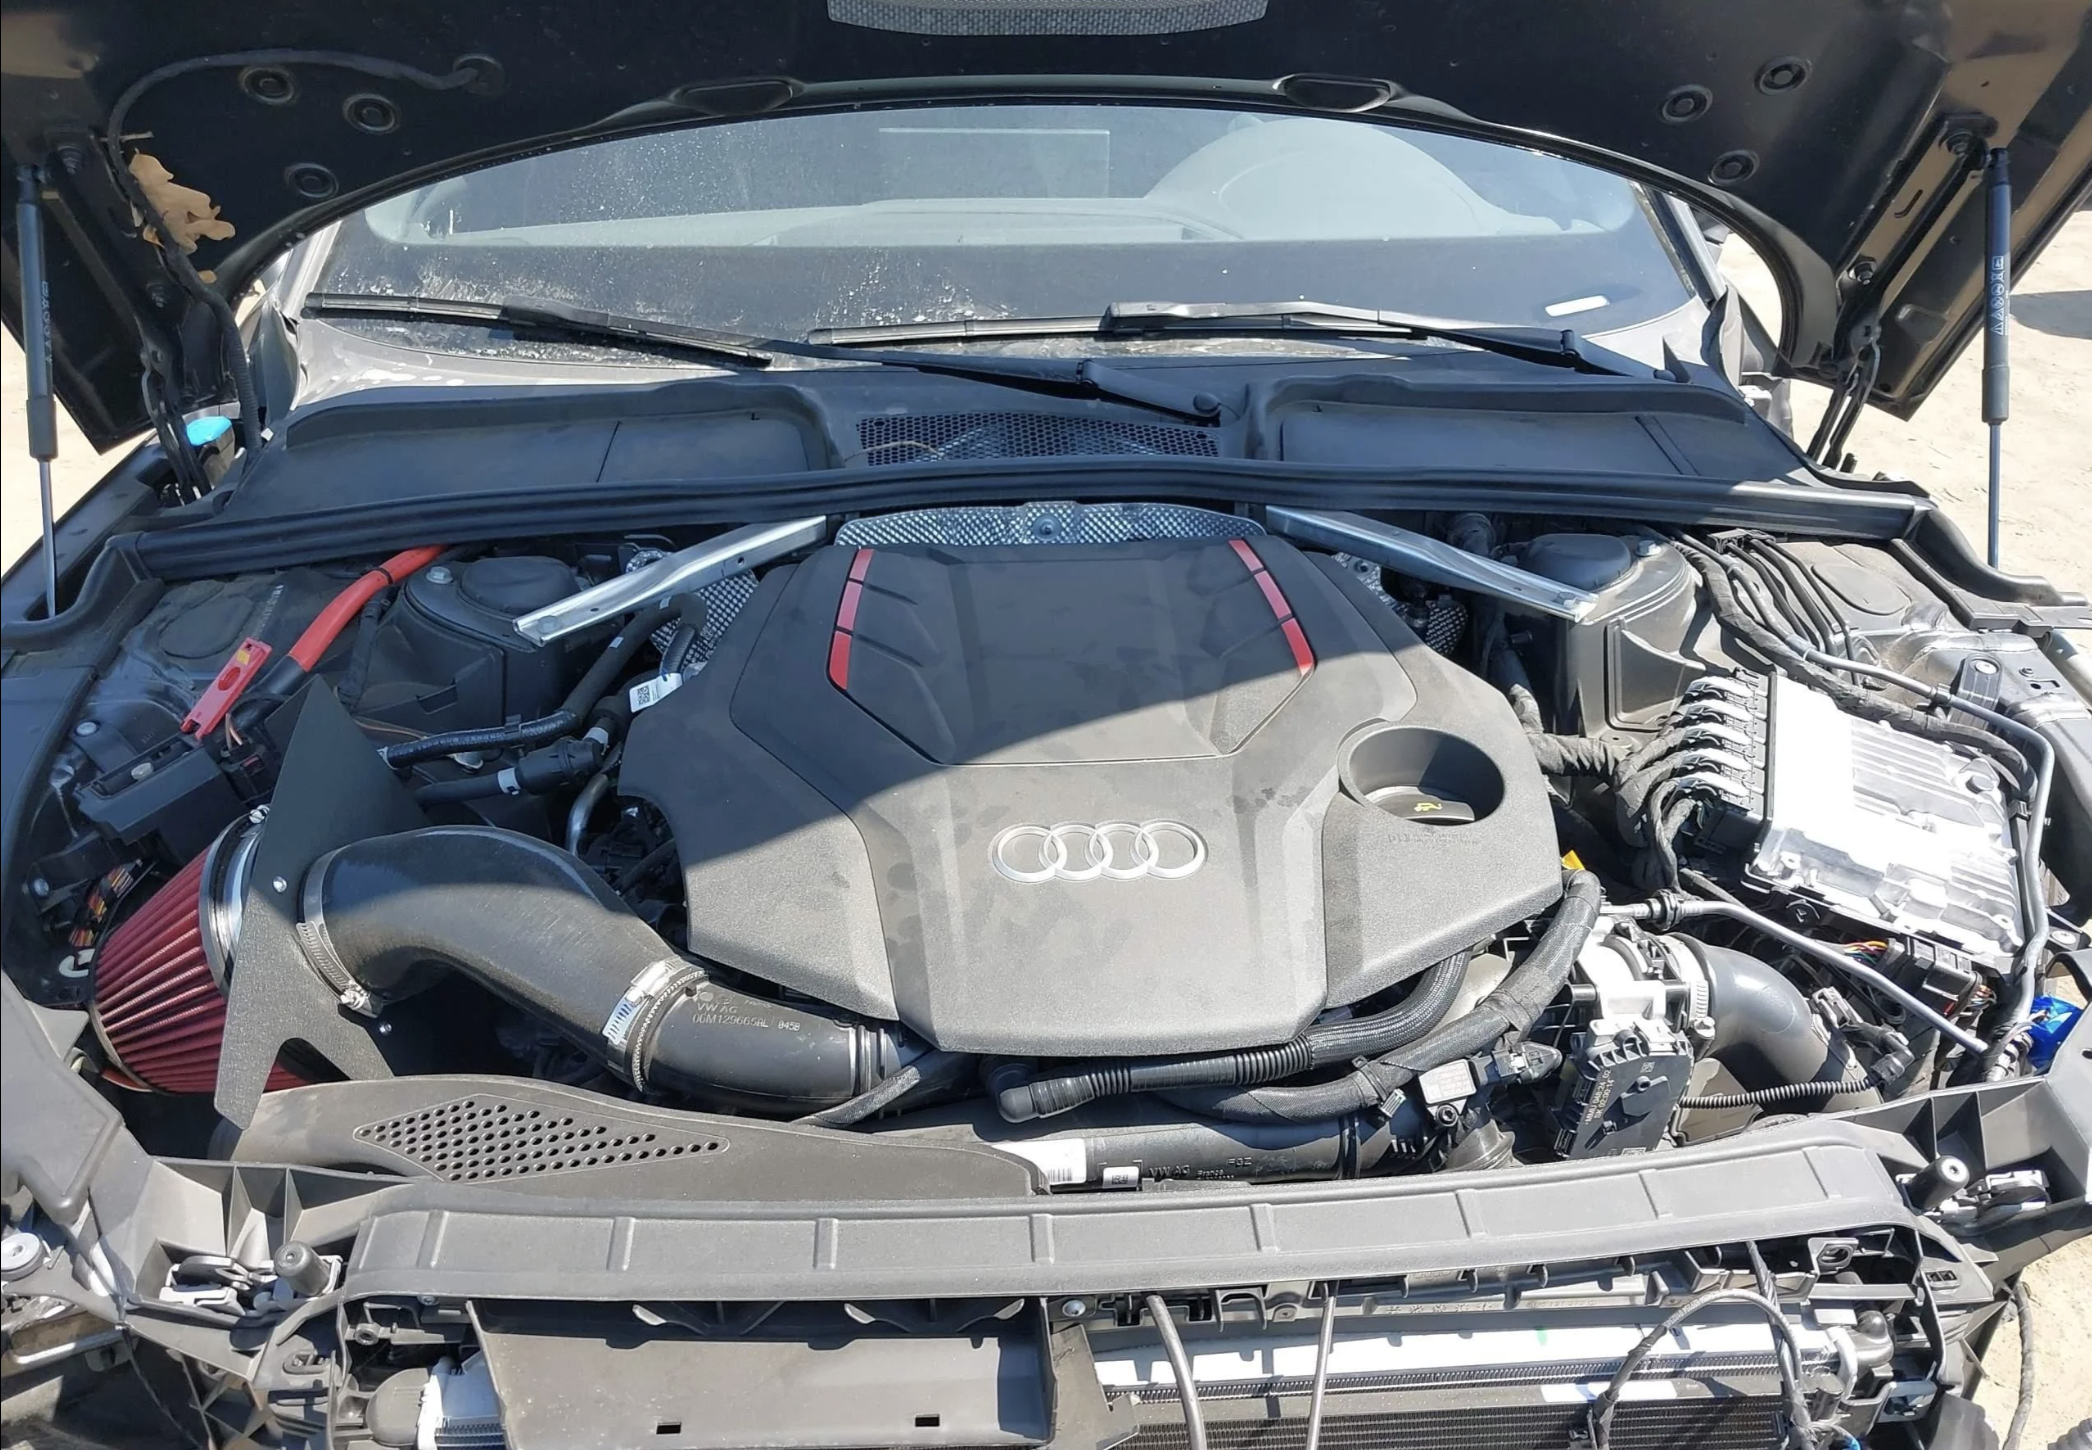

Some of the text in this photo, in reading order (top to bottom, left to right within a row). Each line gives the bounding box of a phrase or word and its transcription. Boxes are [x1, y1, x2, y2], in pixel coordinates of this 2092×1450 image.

[697, 1002, 739, 1014] VW AG
[1149, 1165, 1171, 1178] VW
[1173, 1164, 1191, 1176] AG
